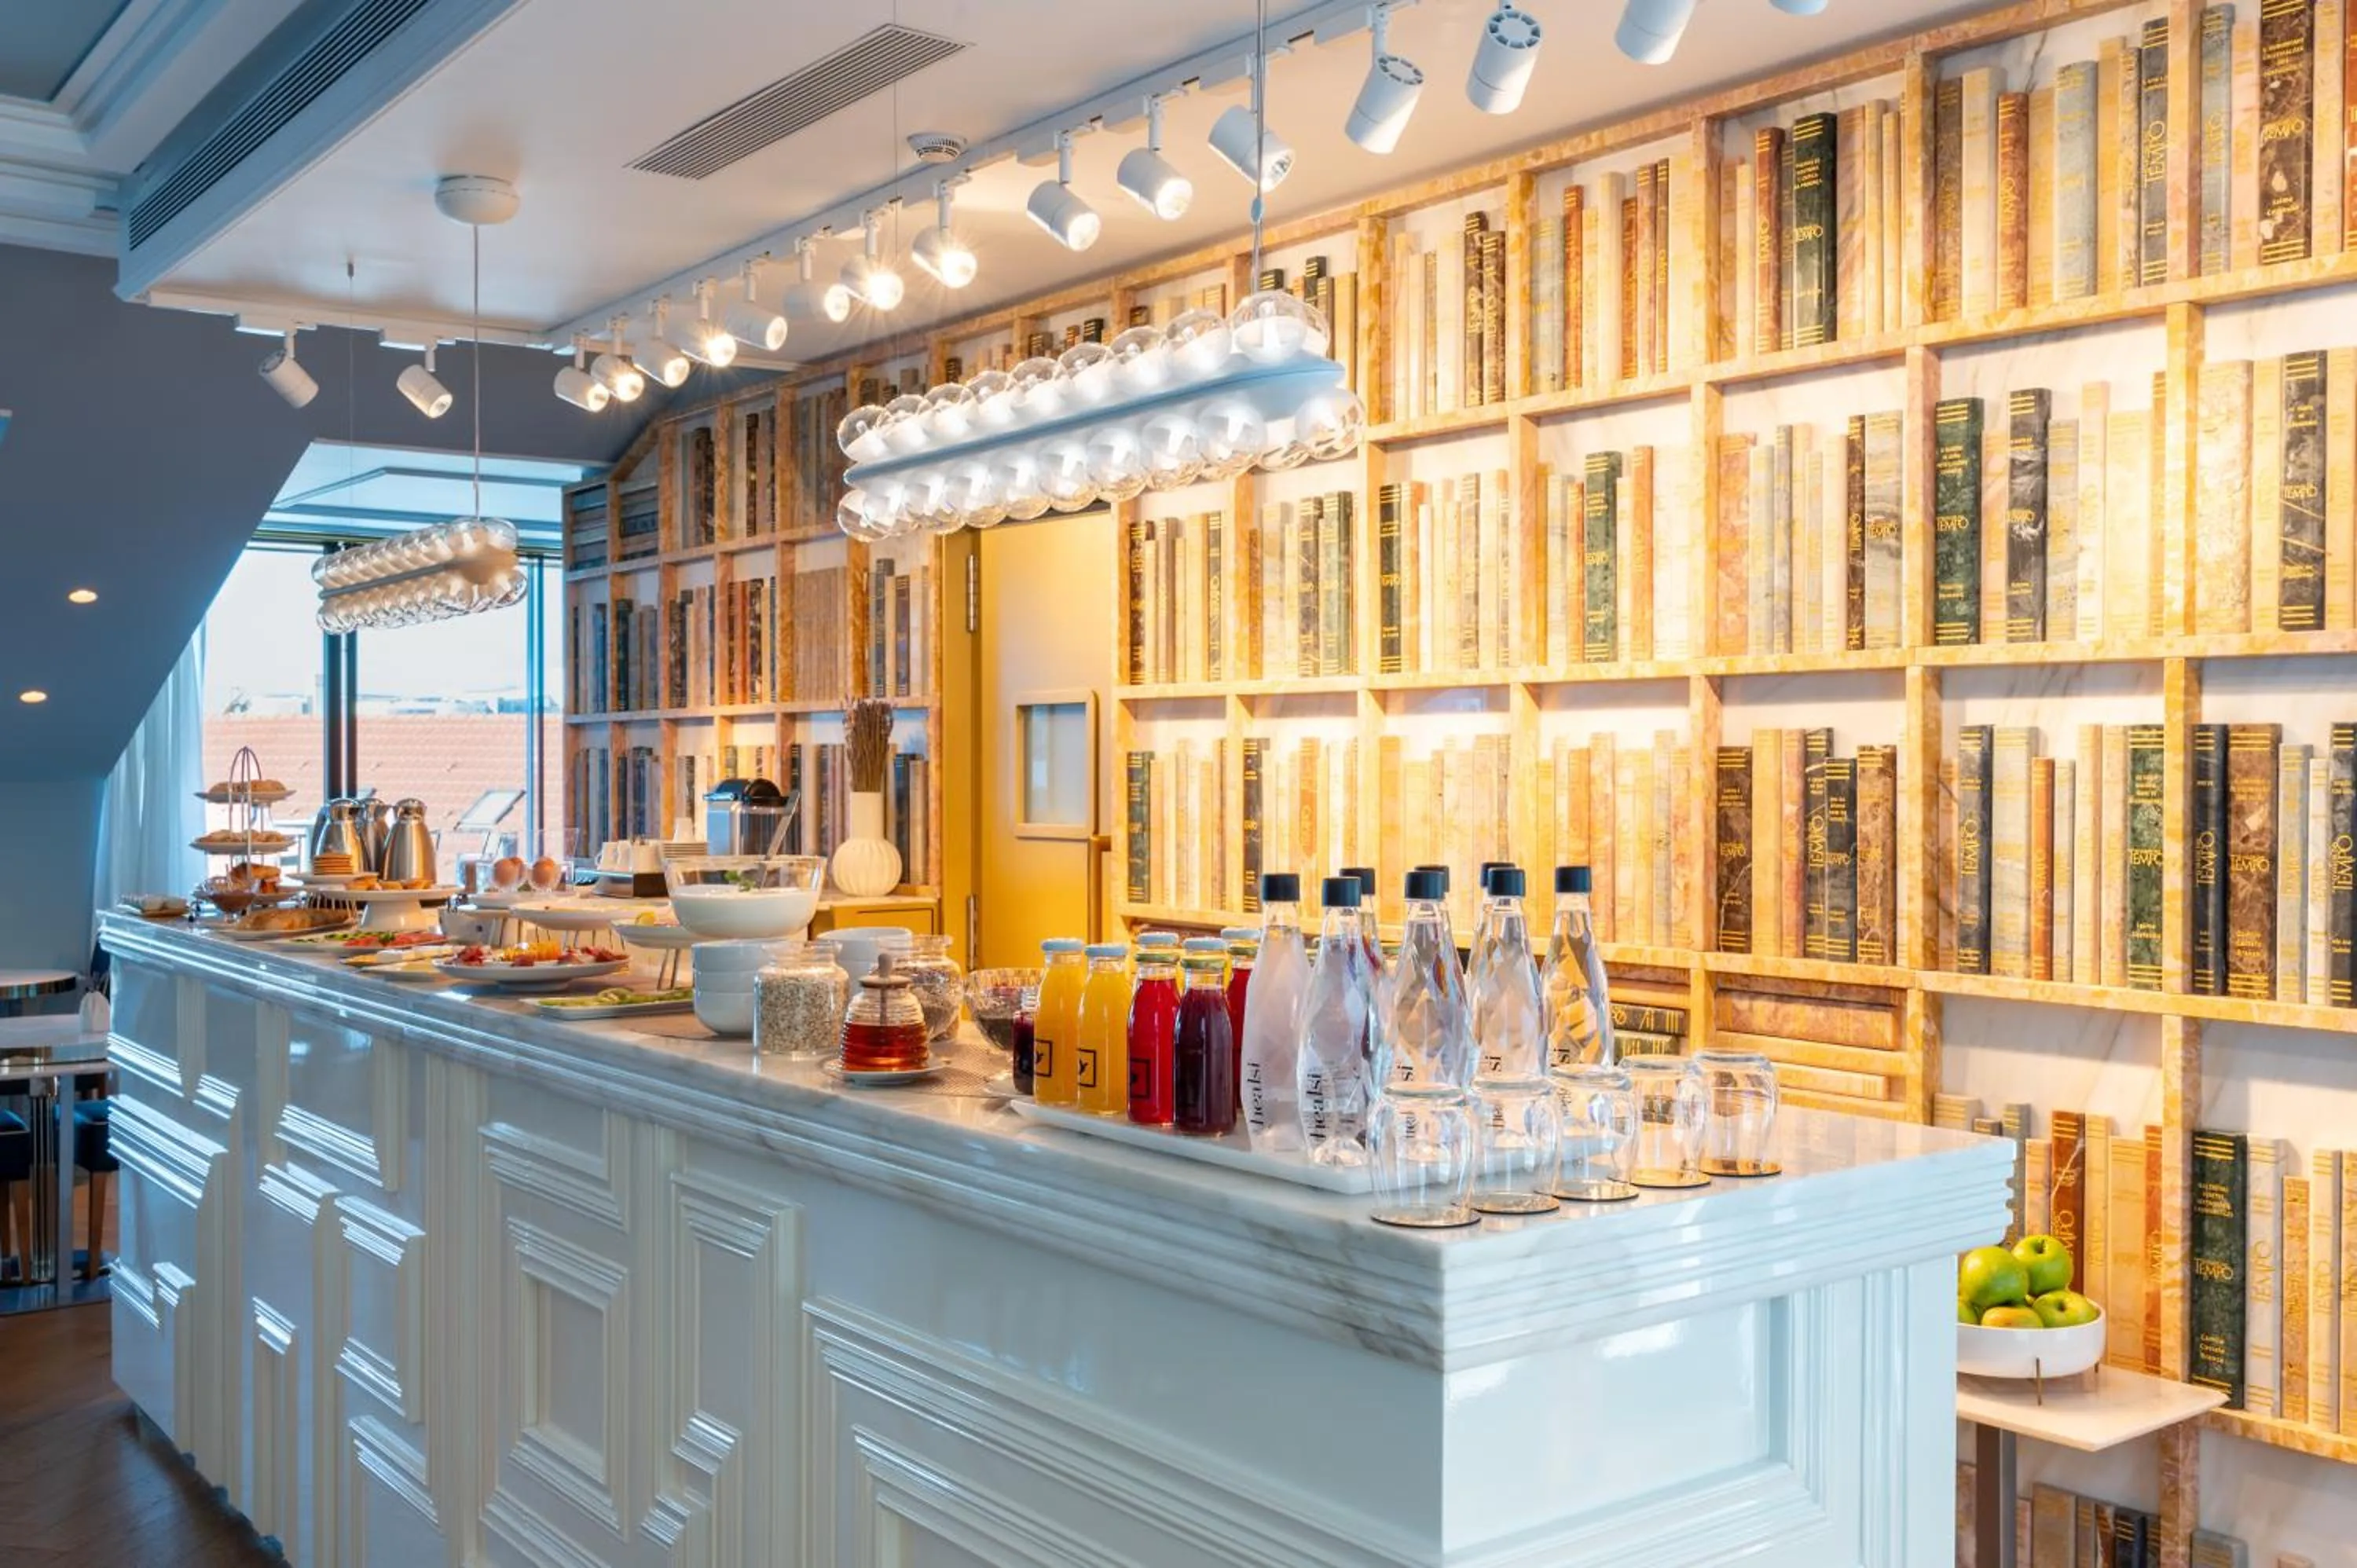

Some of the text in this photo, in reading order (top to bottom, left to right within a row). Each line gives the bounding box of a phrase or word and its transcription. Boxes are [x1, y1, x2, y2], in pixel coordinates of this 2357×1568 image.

[2144, 121, 2165, 188] TEMPO
[1937, 515, 1969, 532] TEMPO
[1809, 815, 1825, 869] TEMPO
[1961, 819, 1980, 877] TEMPO
[2130, 848, 2163, 866] TEMPO
[2198, 831, 2217, 885] TEMPO
[2230, 854, 2269, 873] TEMPO
[2333, 834, 2355, 891] TEMPO
[1247, 1062, 1264, 1126] healsi
[1306, 1073, 1326, 1138] healsi
[2194, 1258, 2234, 1280] TEMPO
[2250, 1240, 2275, 1305] TEMPO
